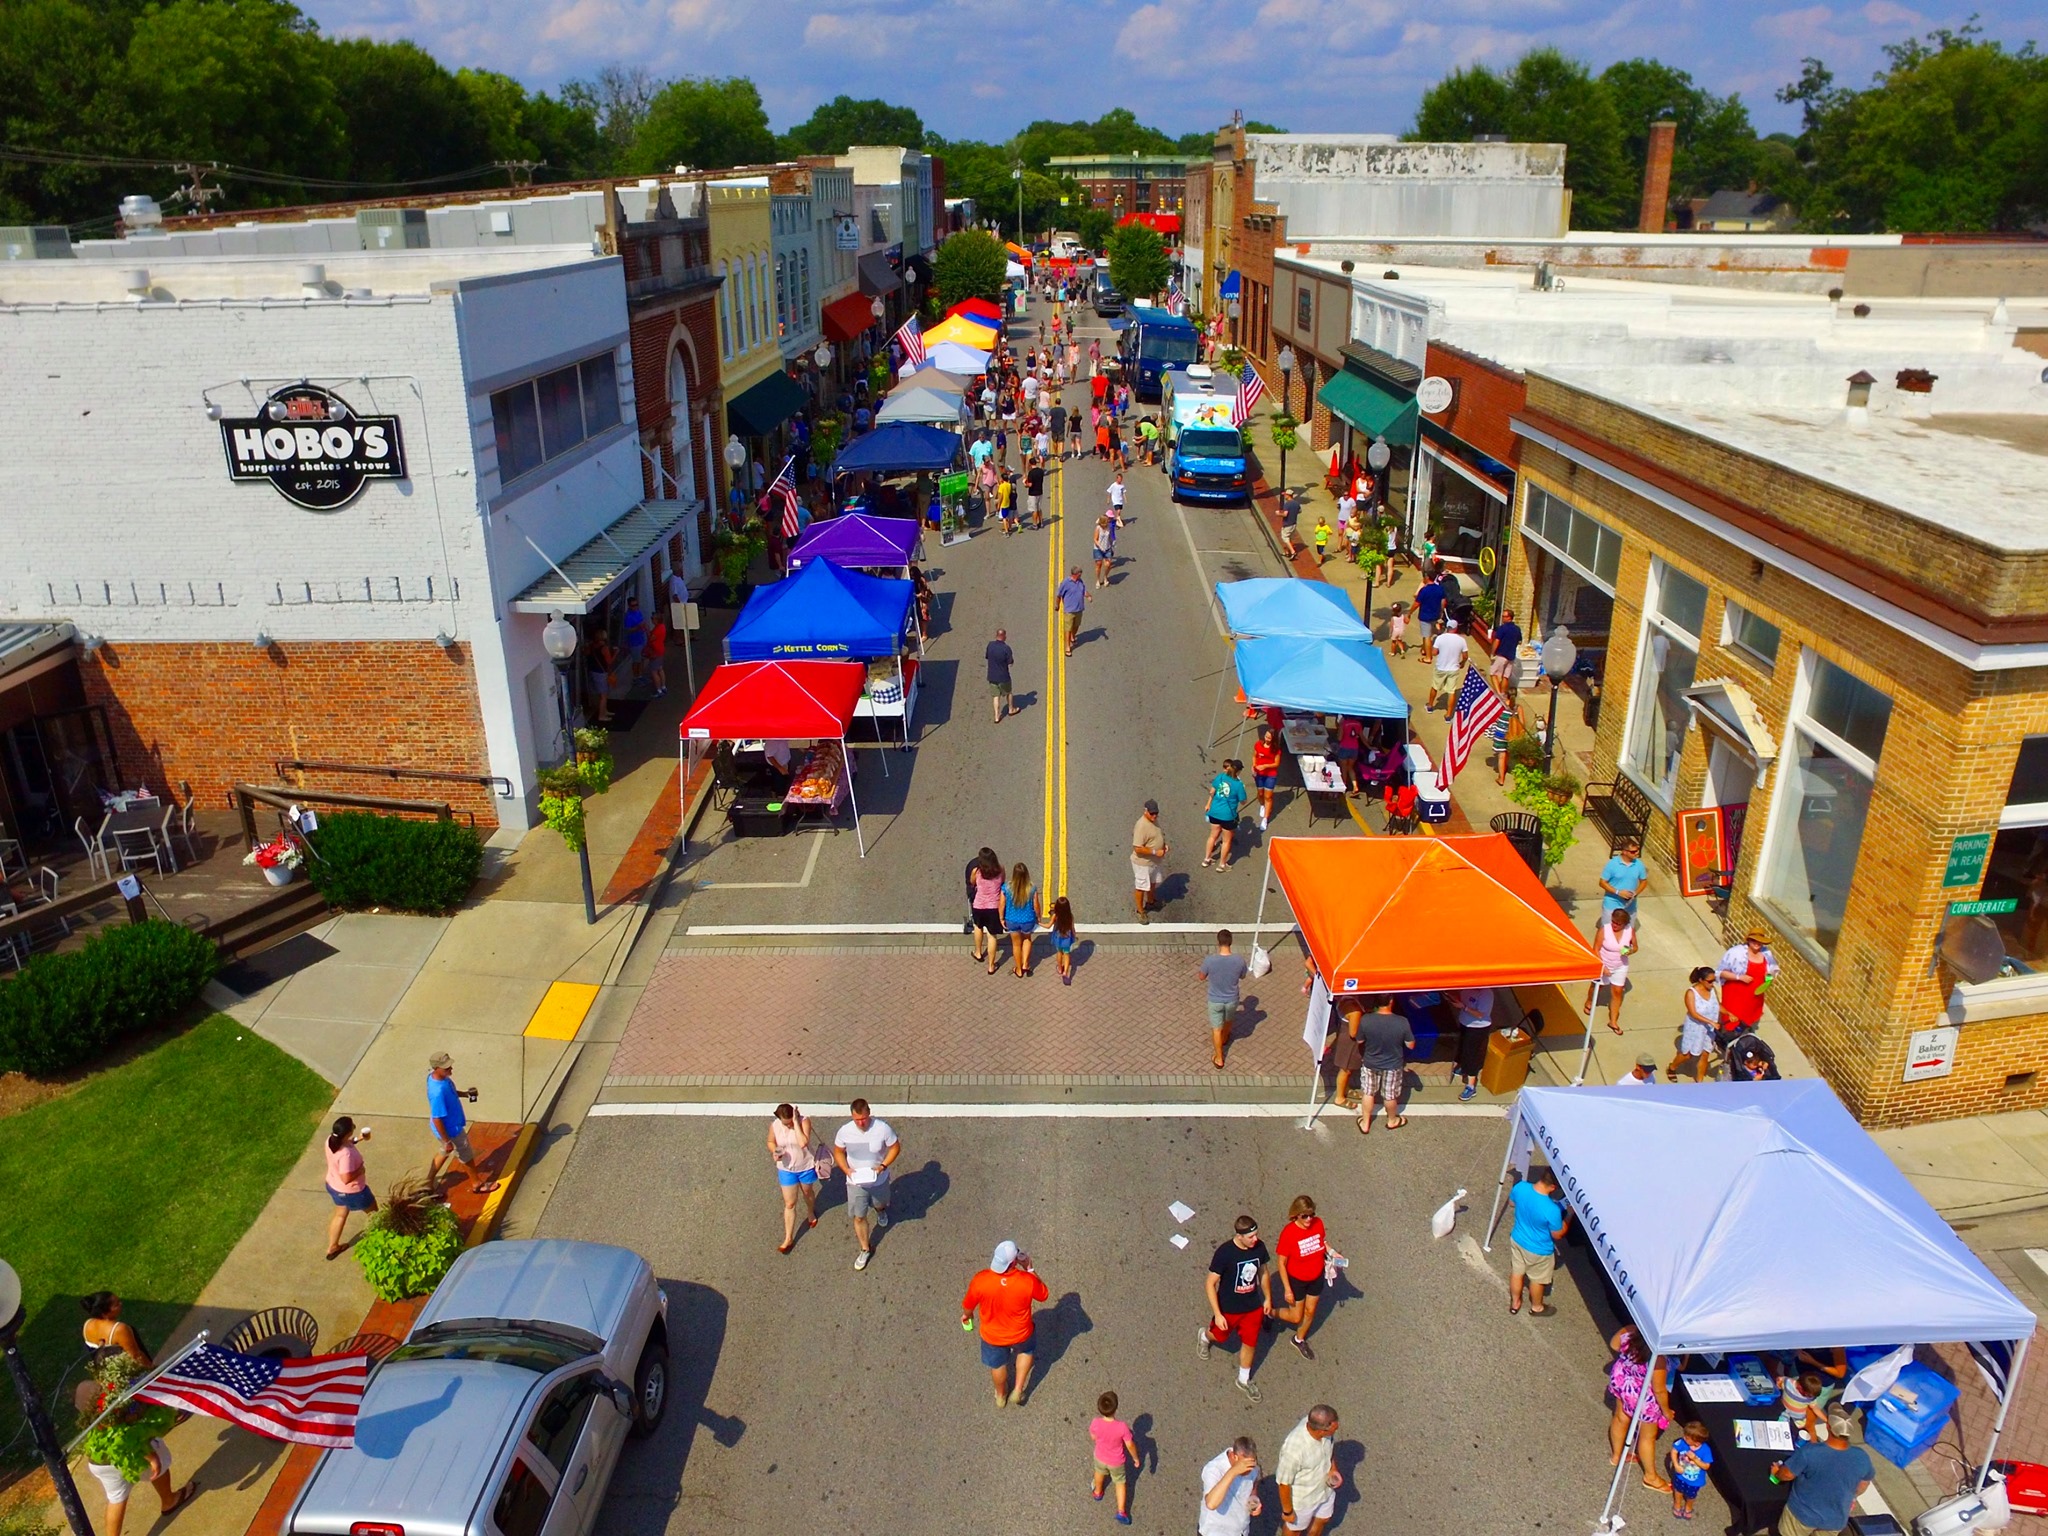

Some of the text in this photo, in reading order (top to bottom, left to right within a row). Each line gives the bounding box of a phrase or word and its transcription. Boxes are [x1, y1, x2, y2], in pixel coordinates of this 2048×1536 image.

[233, 426, 389, 461] HOBO'S
[240, 462, 287, 473] burgers
[300, 461, 341, 471] shakes
[295, 479, 341, 490] est. 2015
[784, 643, 839, 653] KETTLE CORN
[1952, 839, 1988, 852] PARKING
[1948, 854, 1984, 867] IN REAR
[1951, 901, 2006, 914] CONFEDERATE
[1918, 1044, 1947, 1054] Bakery
[1561, 1164, 1638, 1303] FOUNDATION
[1300, 1244, 1321, 1254] ACTION
